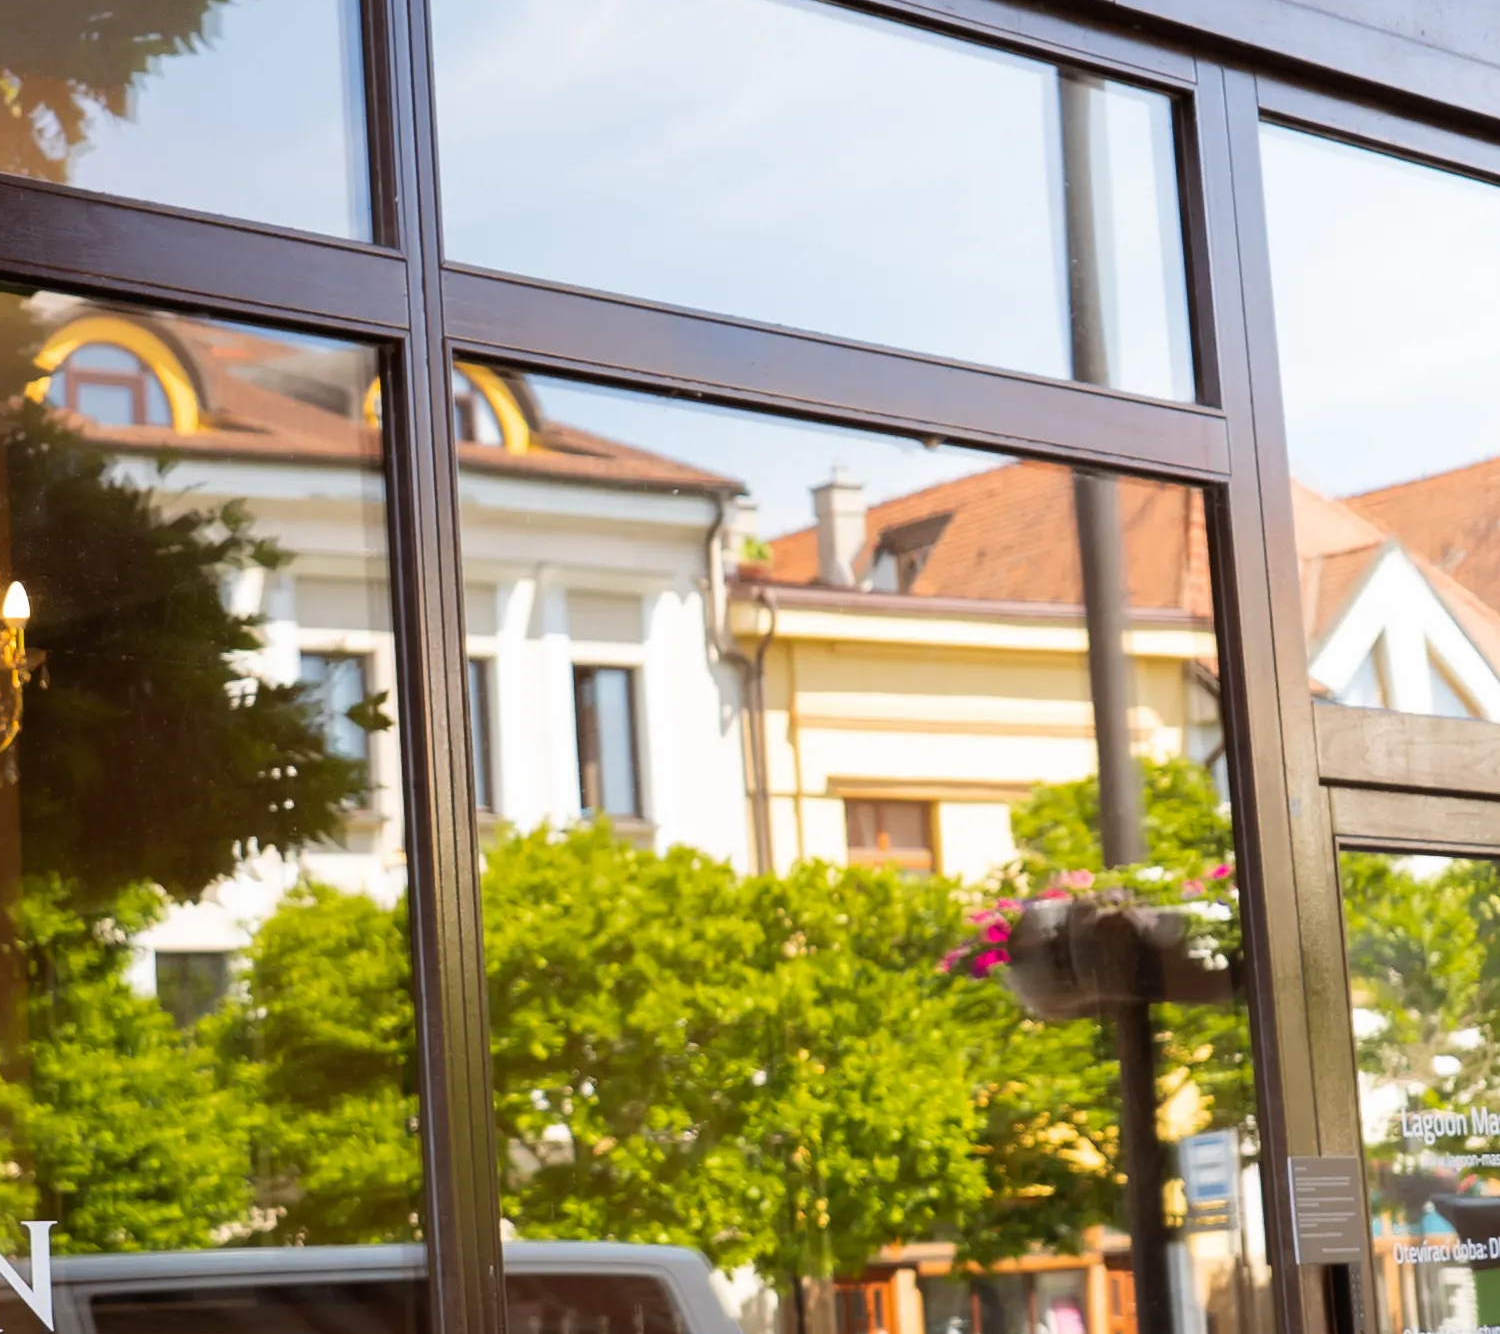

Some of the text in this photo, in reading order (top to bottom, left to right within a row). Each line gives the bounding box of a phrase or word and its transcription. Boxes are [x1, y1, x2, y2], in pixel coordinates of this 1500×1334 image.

[1401, 1108, 1468, 1145] Lagoon
[1393, 1238, 1450, 1264] Otevírací
[1452, 1237, 1487, 1261] doba:
